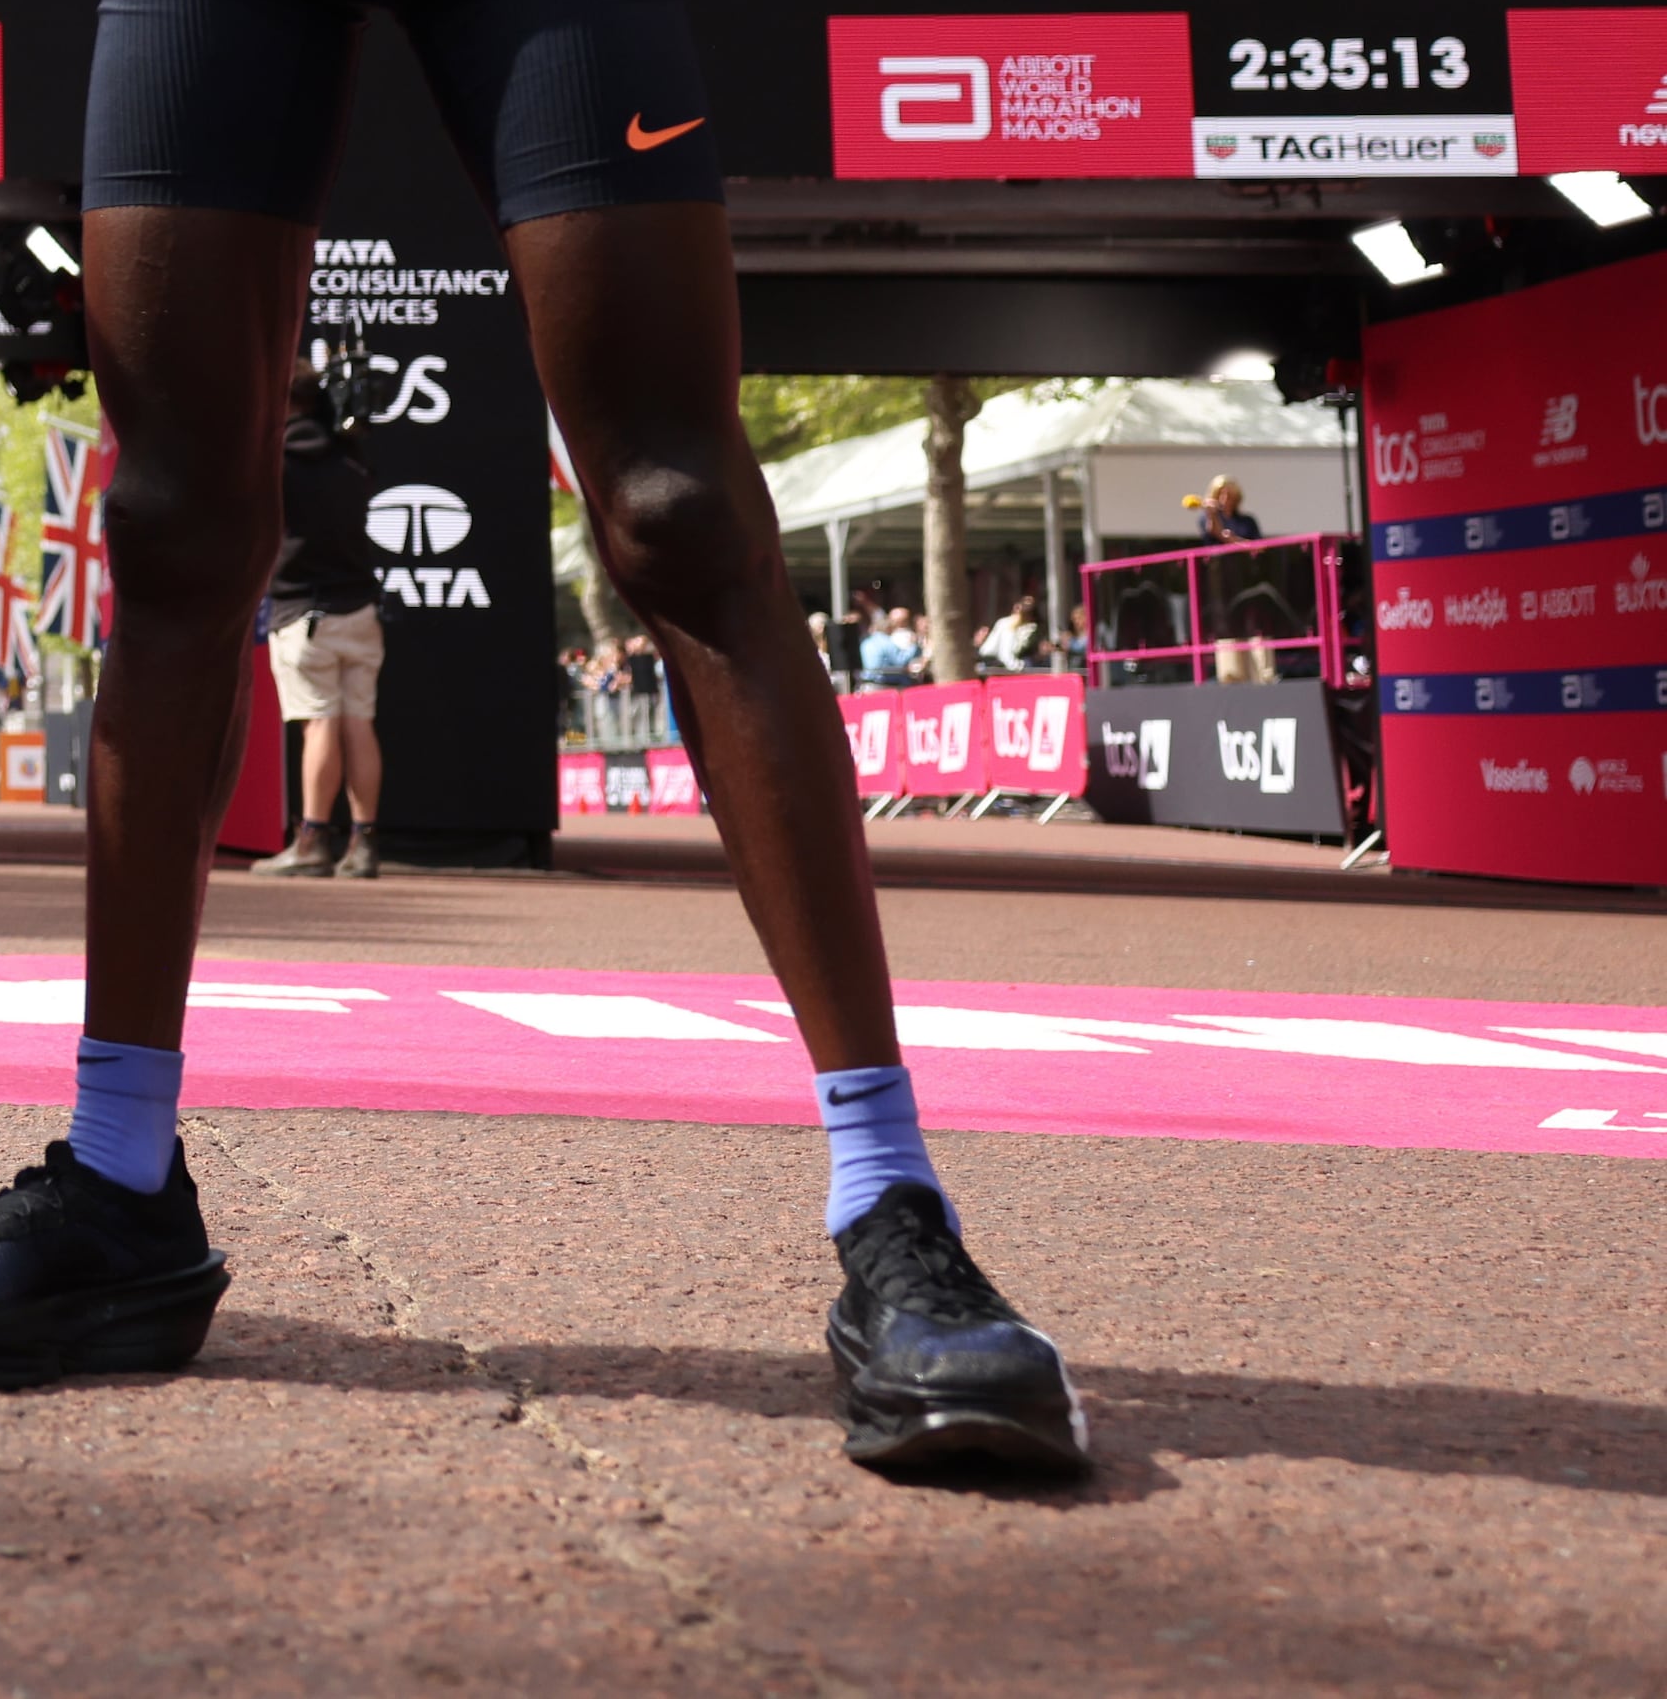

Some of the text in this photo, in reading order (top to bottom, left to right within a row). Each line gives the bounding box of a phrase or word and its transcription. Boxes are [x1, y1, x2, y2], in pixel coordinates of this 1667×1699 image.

[999, 54, 1097, 77] ABBOTT
[1228, 35, 1471, 93] 2:35:13
[998, 76, 1093, 97] WORLD
[999, 96, 1142, 119] MARATHON
[1000, 118, 1101, 141] MAJORS
[1250, 131, 1460, 166] TAGHeuer
[313, 238, 397, 265] TATA
[309, 268, 510, 296] CONSULTANCY
[310, 298, 439, 325] SERVICES
[1633, 372, 1667, 446] tc
[1372, 420, 1419, 487] tcs
[375, 567, 493, 609] ATA
[1216, 719, 1262, 783] tcs
